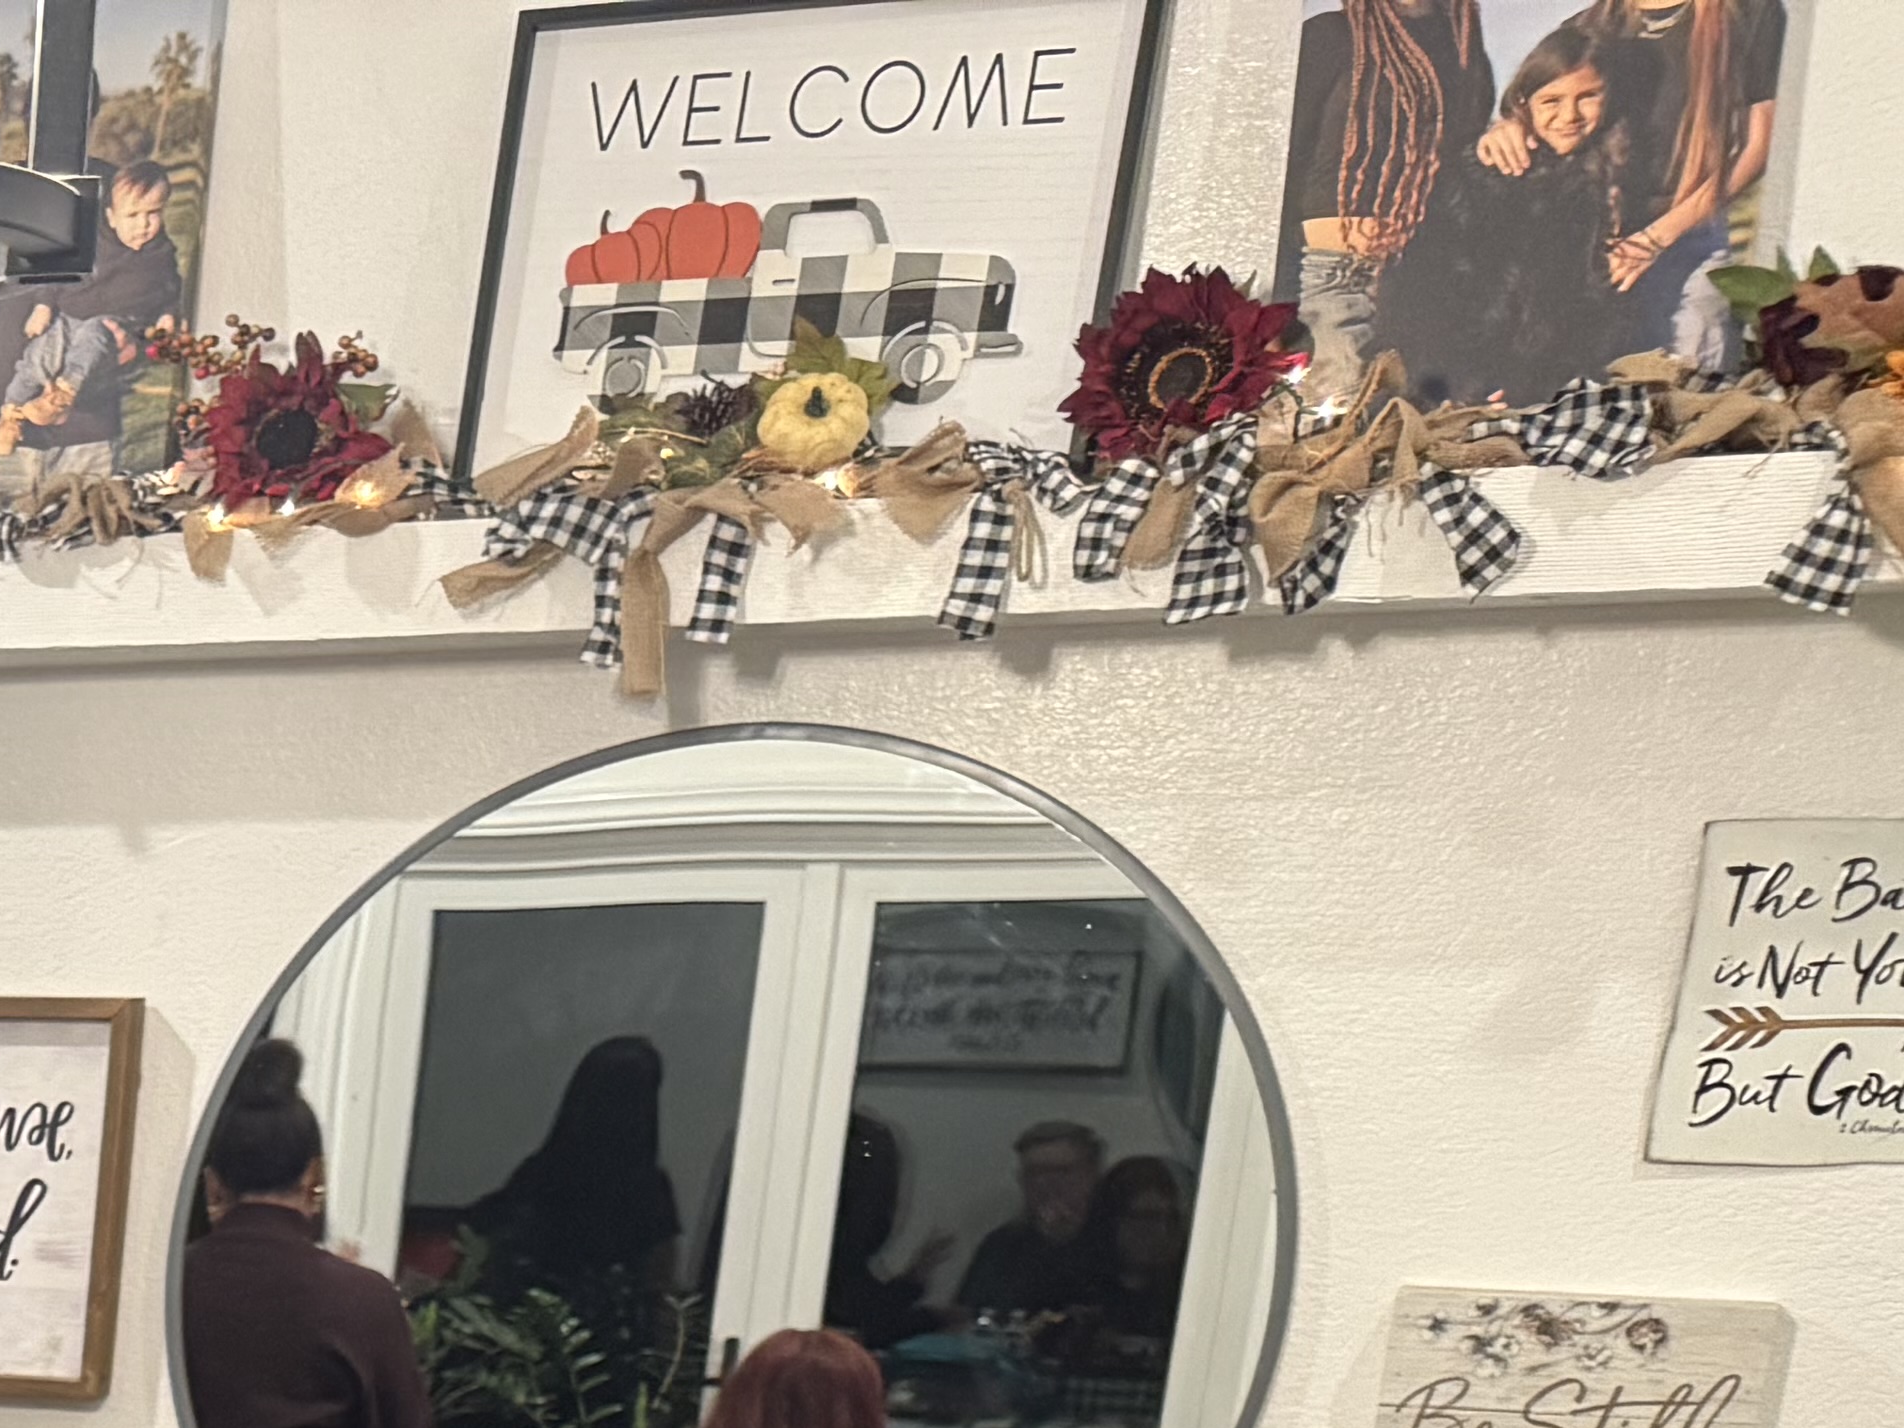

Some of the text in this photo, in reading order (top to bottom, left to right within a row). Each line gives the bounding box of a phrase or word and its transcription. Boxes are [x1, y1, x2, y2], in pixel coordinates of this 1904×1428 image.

[590, 47, 1077, 151] WELCOME
[1726, 861, 1822, 927] The
[1713, 955, 1755, 987] is
[1757, 939, 1846, 999] Not
[1688, 1057, 1804, 1128] But
